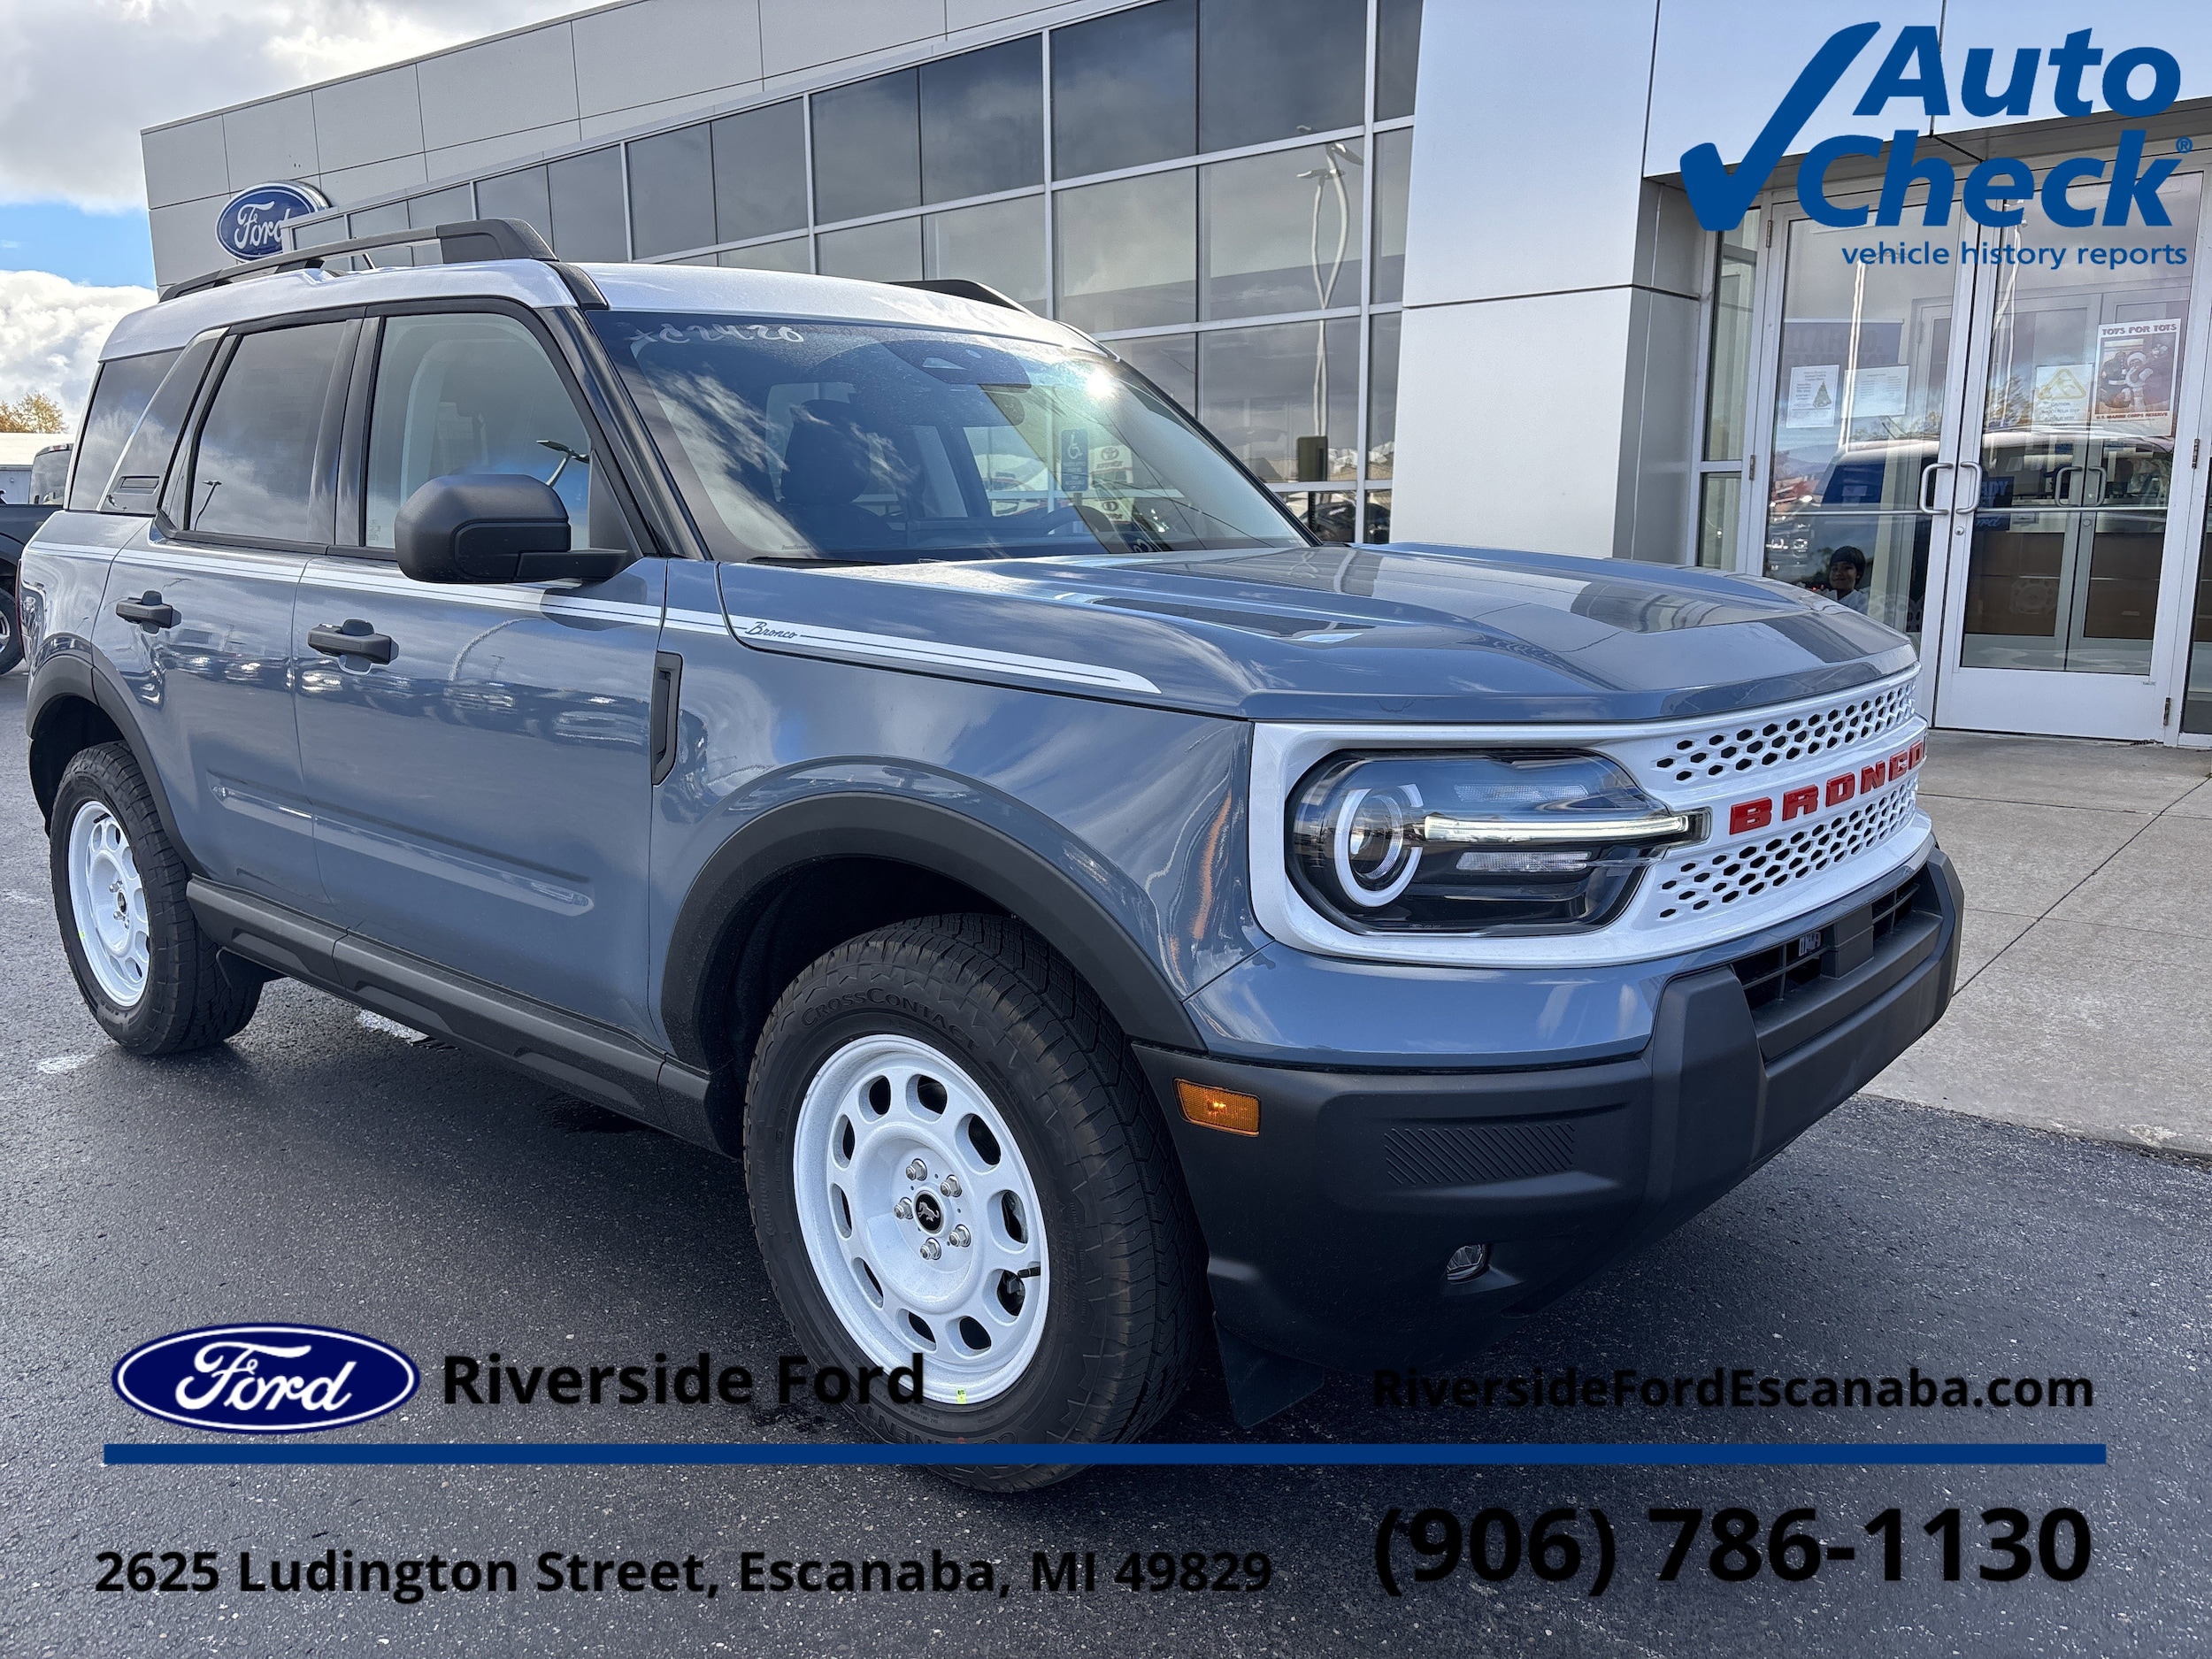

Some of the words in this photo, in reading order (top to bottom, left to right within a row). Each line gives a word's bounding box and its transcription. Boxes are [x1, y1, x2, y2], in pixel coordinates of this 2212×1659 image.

[234, 200, 290, 250] Ford
[745, 621, 798, 639] Bronco
[1729, 740, 1924, 835] BRONCO
